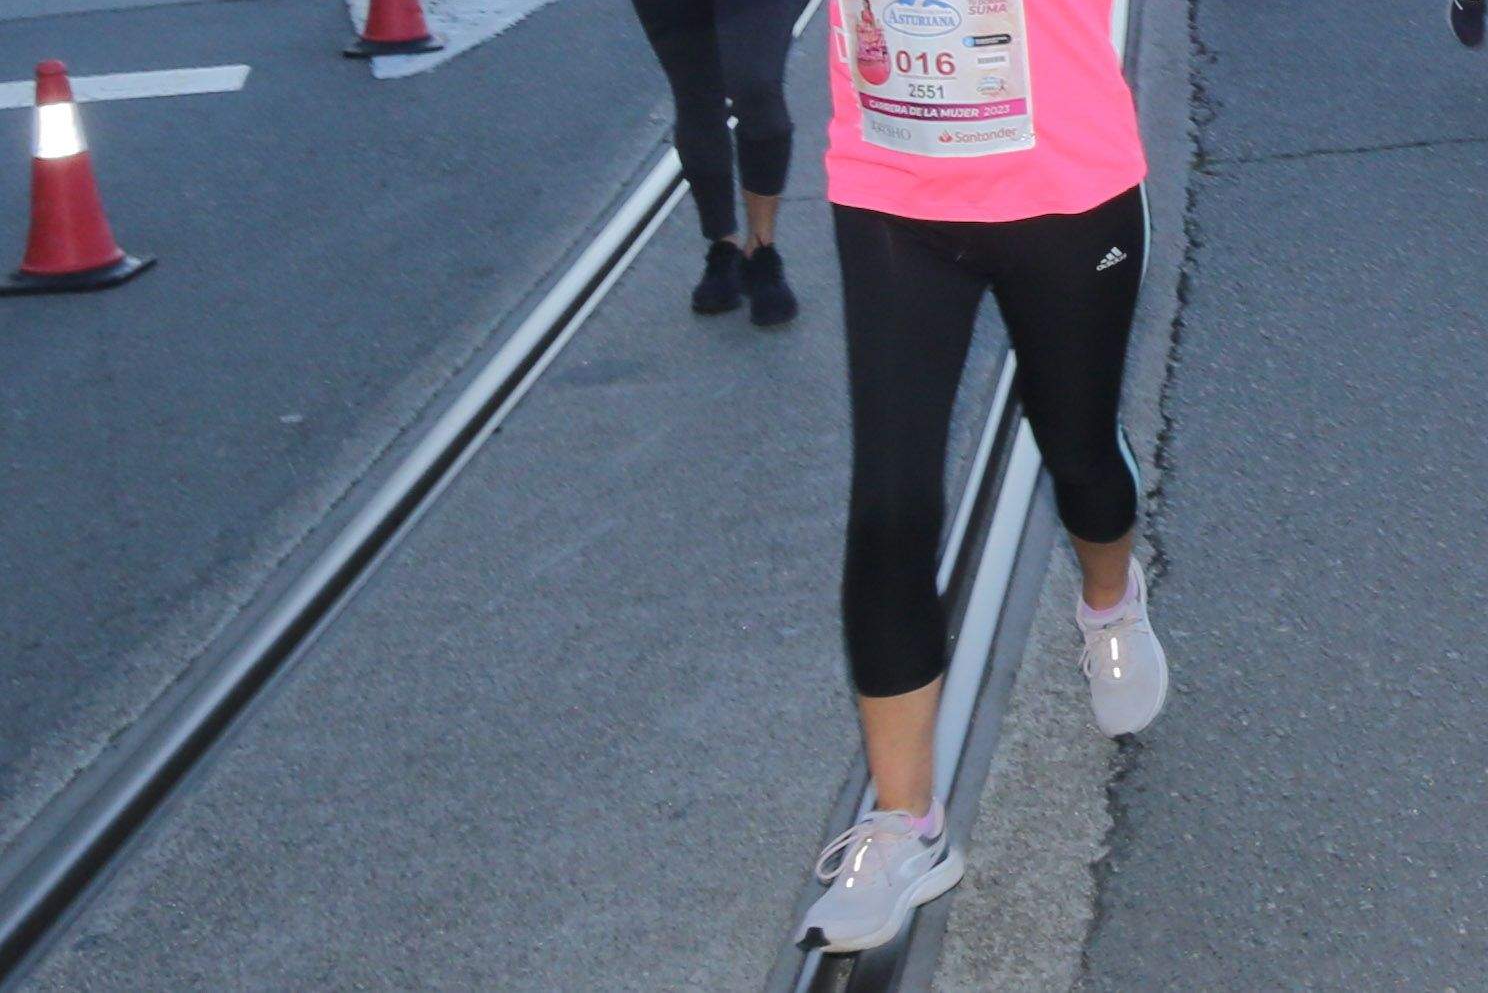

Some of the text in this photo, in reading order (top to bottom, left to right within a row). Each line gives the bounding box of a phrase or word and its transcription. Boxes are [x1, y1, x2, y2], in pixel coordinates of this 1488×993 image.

[889, 8, 956, 27] ASTURIANA
[968, 5, 1008, 16] SUMA
[896, 50, 956, 75] 016
[908, 84, 944, 99] 2551
[909, 107, 922, 117] DE
[923, 108, 939, 118] LA
[939, 107, 980, 118] MUJER
[983, 104, 1010, 118] 2023
[955, 127, 1018, 144] Santander
